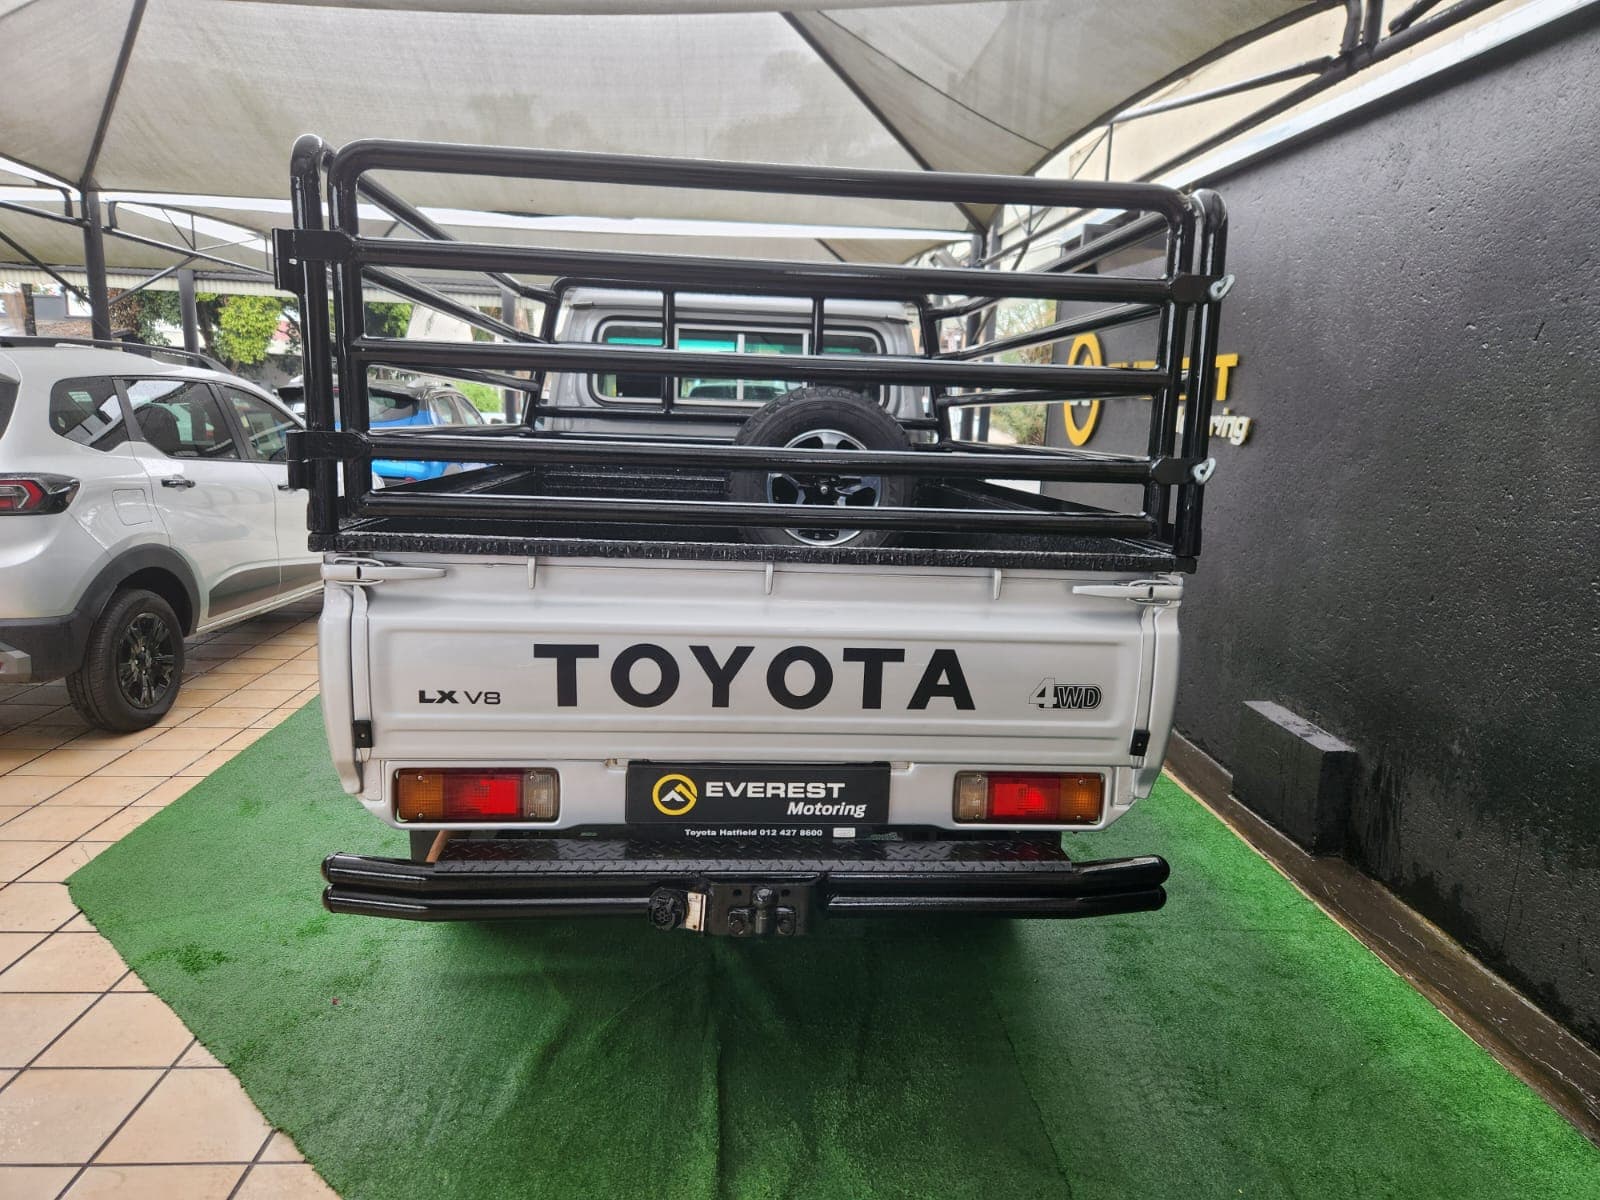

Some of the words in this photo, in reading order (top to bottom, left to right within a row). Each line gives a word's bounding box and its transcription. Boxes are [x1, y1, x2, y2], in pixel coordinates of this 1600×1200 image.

[533, 643, 976, 711] TOYOTA
[418, 689, 459, 704] LX
[464, 691, 501, 705] V8
[1028, 677, 1103, 711] 4WD
[705, 781, 846, 799] EVEREST
[786, 801, 867, 818] Motoring
[684, 828, 717, 838] Toyota
[719, 828, 757, 837] Hatfield
[759, 828, 777, 837] 012
[779, 828, 797, 837] 427
[799, 828, 823, 837] 8600
